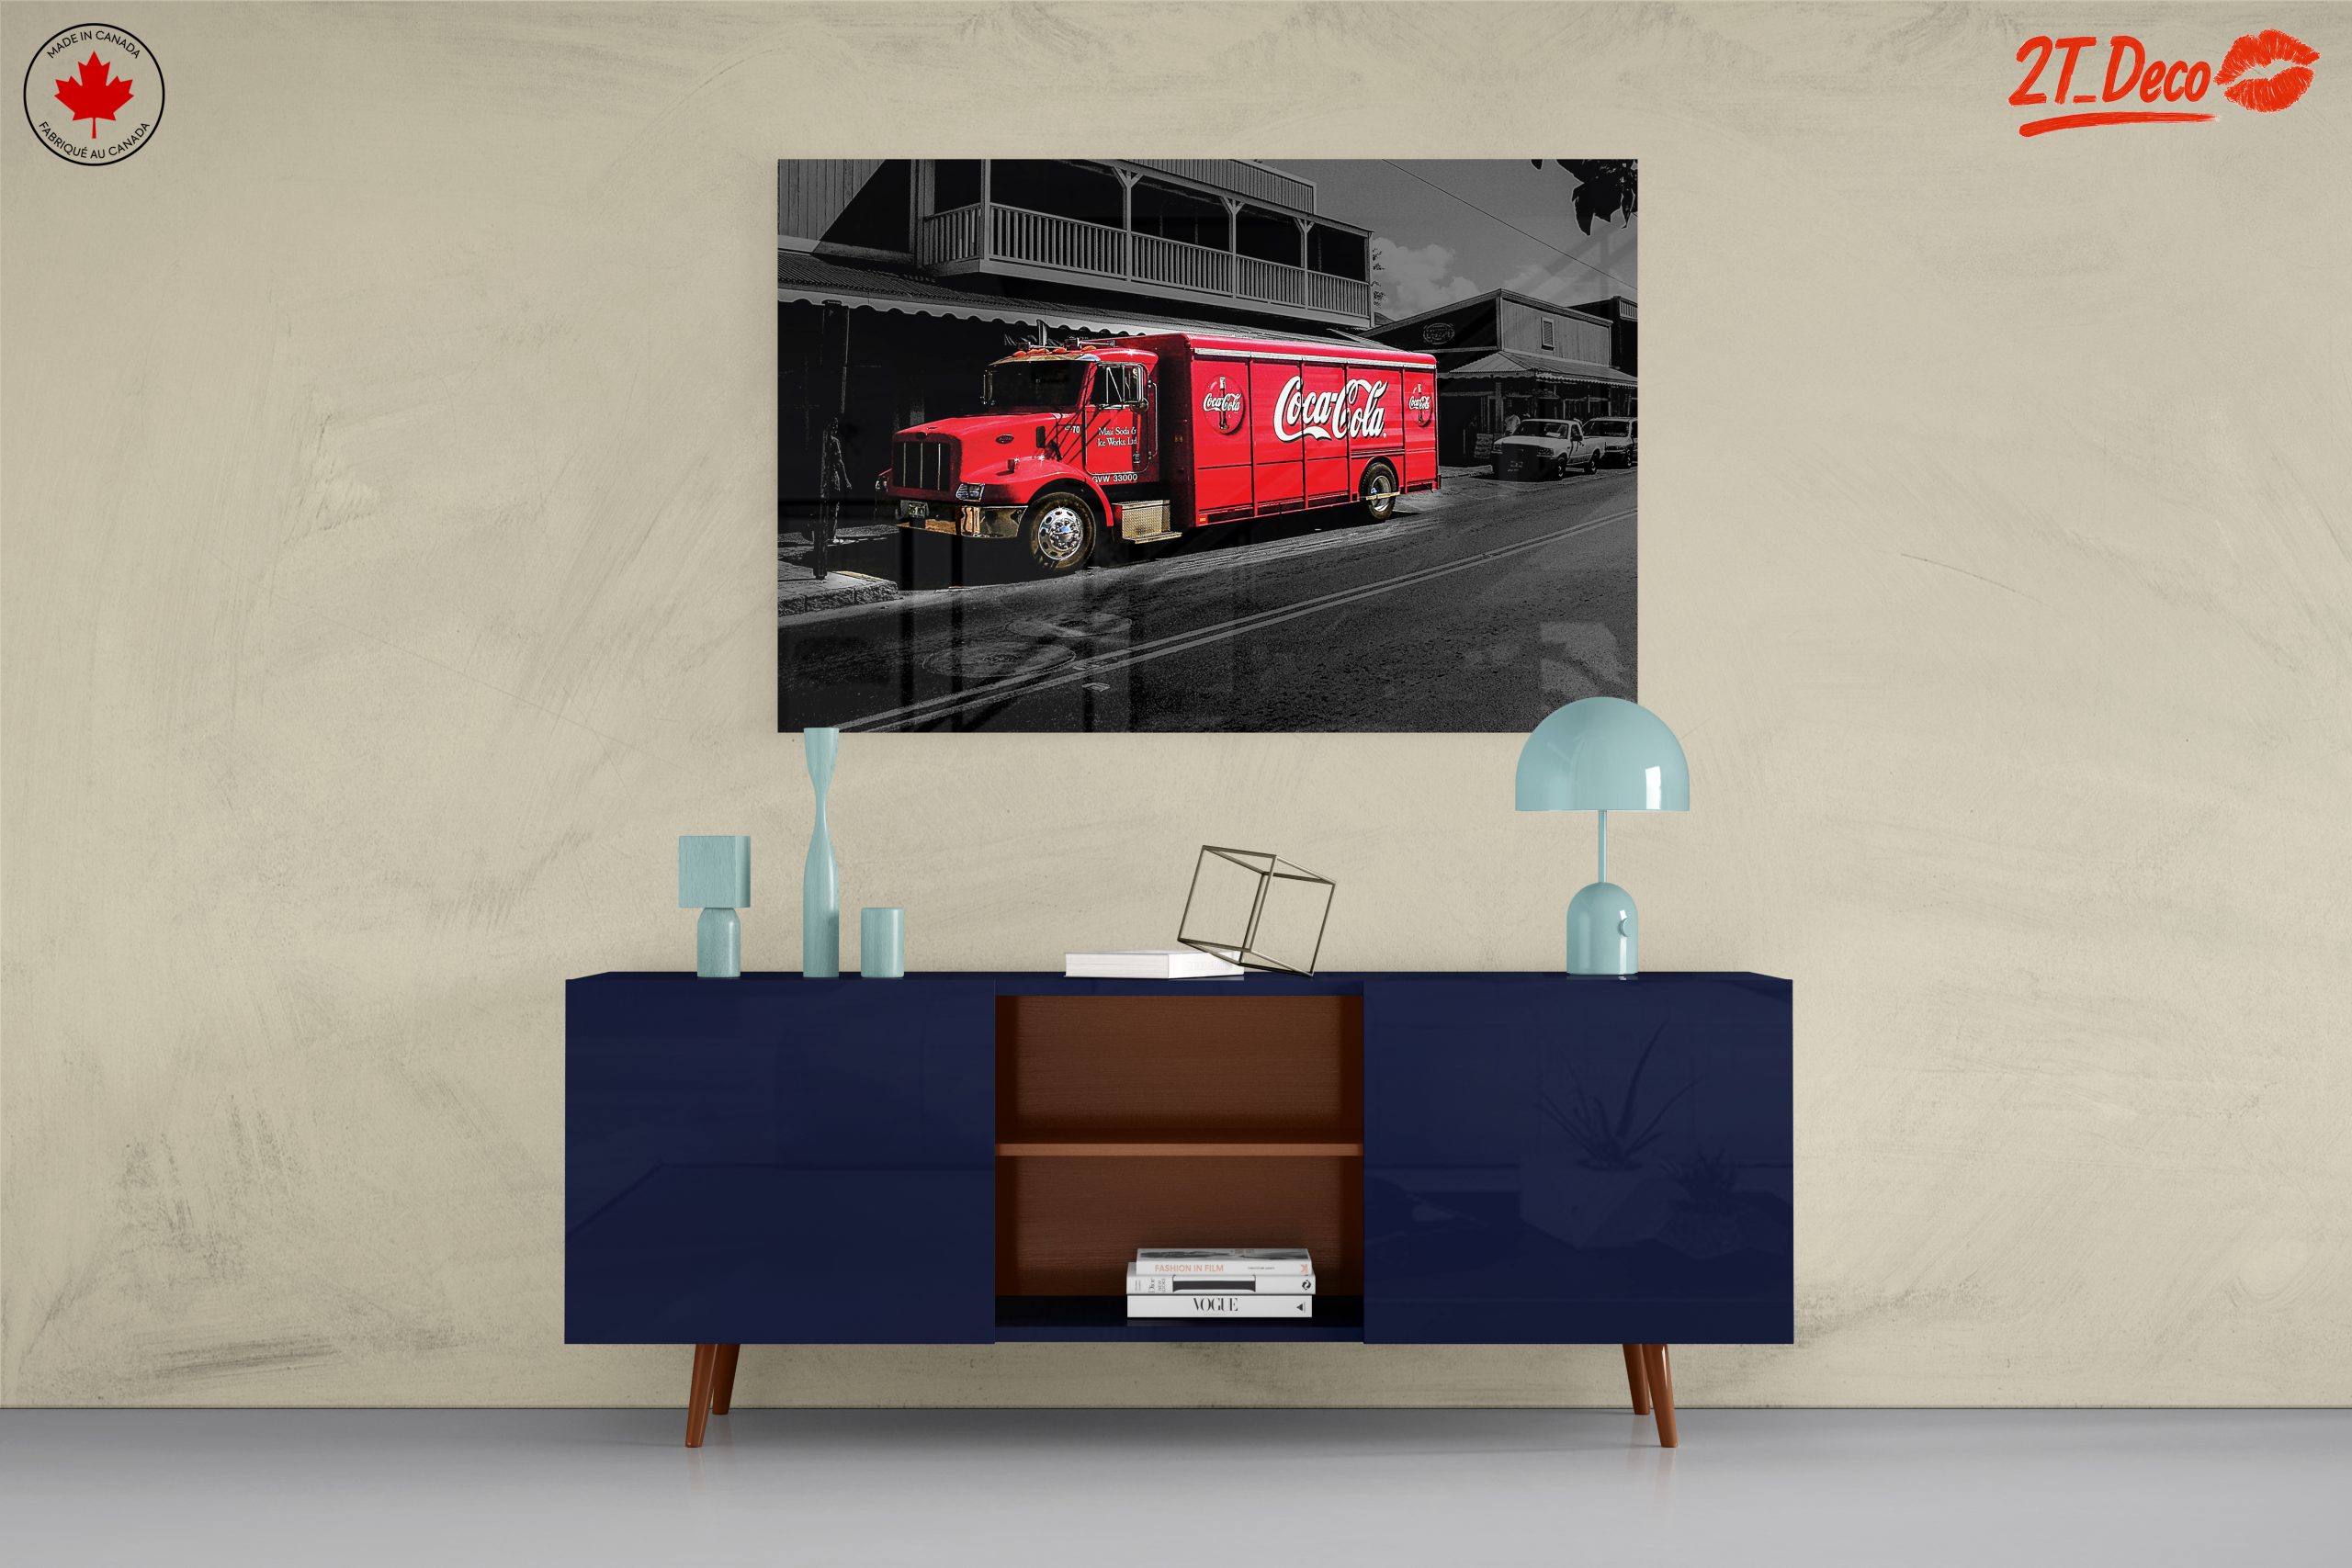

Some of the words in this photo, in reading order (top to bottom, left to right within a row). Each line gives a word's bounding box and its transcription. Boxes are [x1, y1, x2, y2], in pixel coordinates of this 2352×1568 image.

[1273, 375, 1388, 443] Coca-Cola
[1115, 426, 1130, 435] Soda
[1131, 426, 1137, 435] &
[1097, 438, 1106, 447] Ice
[1106, 436, 1126, 446] Works
[1091, 474, 1111, 483] GVW
[1113, 473, 1138, 482] 33000
[1155, 1264, 1192, 1272] FASHION
[1193, 1264, 1203, 1272] IN
[1204, 1264, 1224, 1272] FILM
[1193, 1297, 1238, 1312] VOGUE
